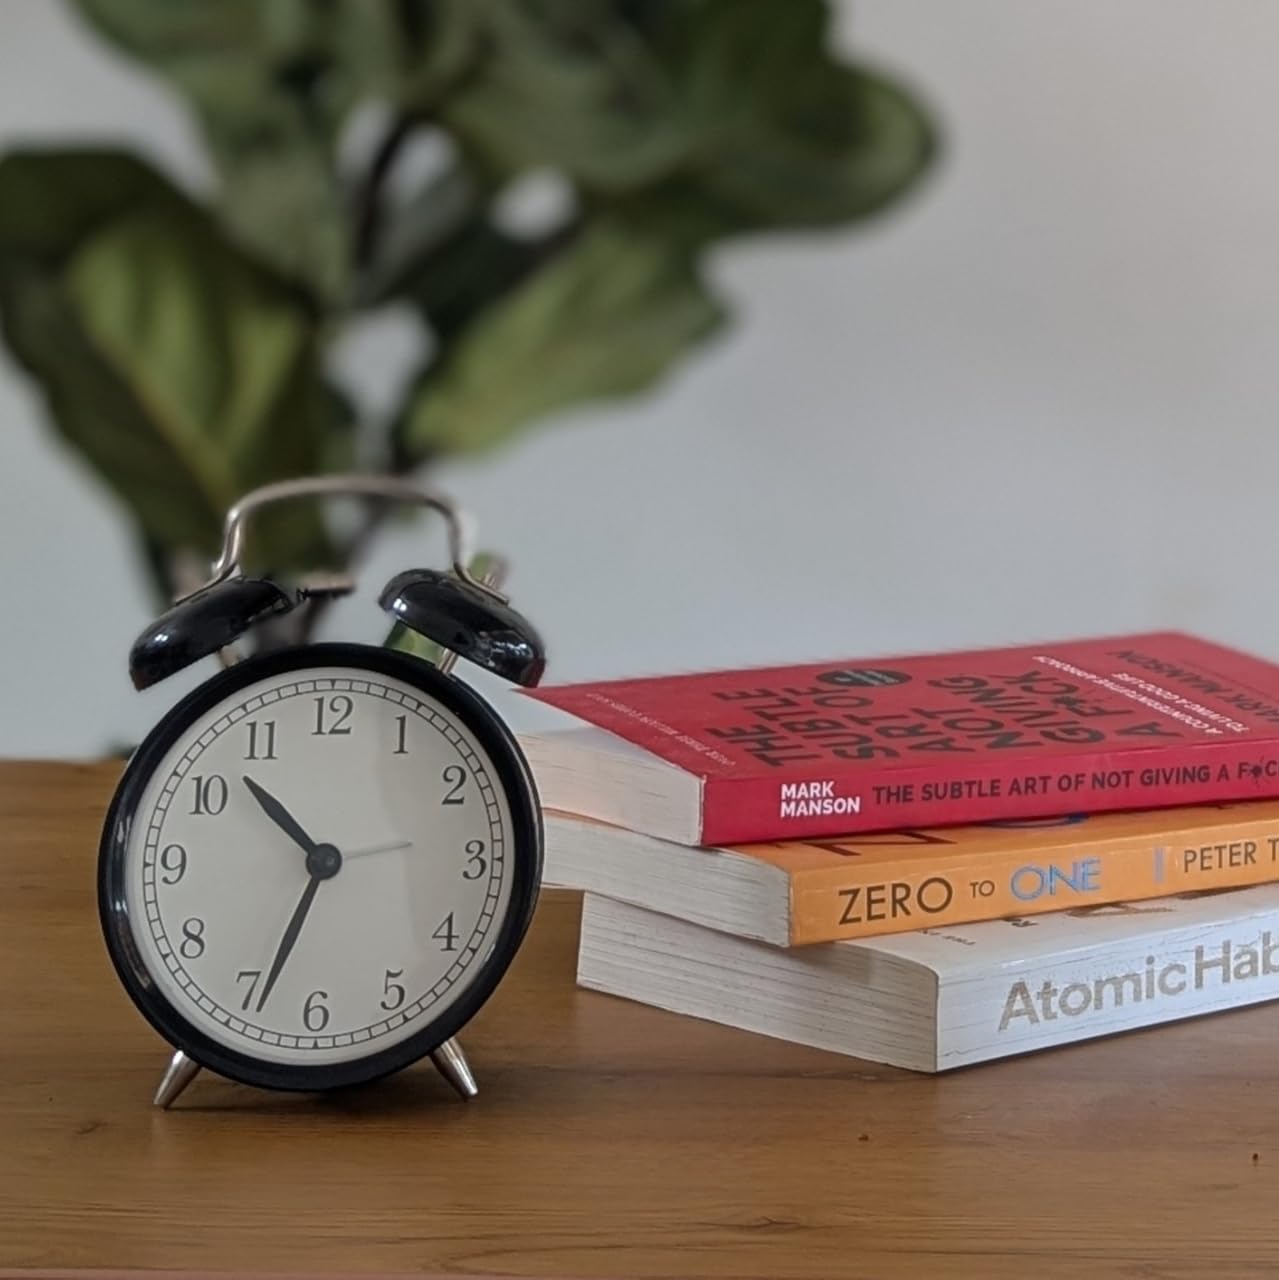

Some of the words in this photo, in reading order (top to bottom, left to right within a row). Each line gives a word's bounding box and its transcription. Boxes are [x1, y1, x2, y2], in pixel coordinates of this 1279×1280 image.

[311, 695, 354, 736] 12
[782, 687, 874, 708] OF
[927, 674, 1105, 744] GIVING
[243, 720, 278, 760] 11
[392, 715, 409, 755] 1
[712, 688, 899, 760] SUBTLE
[841, 713, 975, 752] ART
[910, 708, 1044, 749] NOT
[1114, 721, 1184, 738] A
[704, 724, 822, 766] THE
[189, 774, 228, 815] 10
[441, 765, 467, 805] 2
[781, 781, 835, 800] MARK
[872, 784, 914, 805] THE
[921, 778, 1001, 801] SUBTLE
[1008, 775, 1052, 797] ART
[1057, 774, 1085, 792] OF
[1091, 770, 1134, 790] NOT
[1140, 765, 1210, 787] GIVING
[1216, 764, 1230, 782] A
[780, 796, 861, 818] MANSON
[160, 844, 187, 884] 9
[462, 840, 487, 880] 3
[1184, 841, 1258, 873] PETER
[838, 876, 953, 925] ZERO
[970, 880, 995, 898] TO
[1010, 856, 1101, 901] ONE
[179, 917, 205, 959] 8
[431, 912, 460, 951] 4
[235, 970, 262, 1011] 7
[380, 969, 406, 1010] 5
[303, 991, 329, 1032] 6
